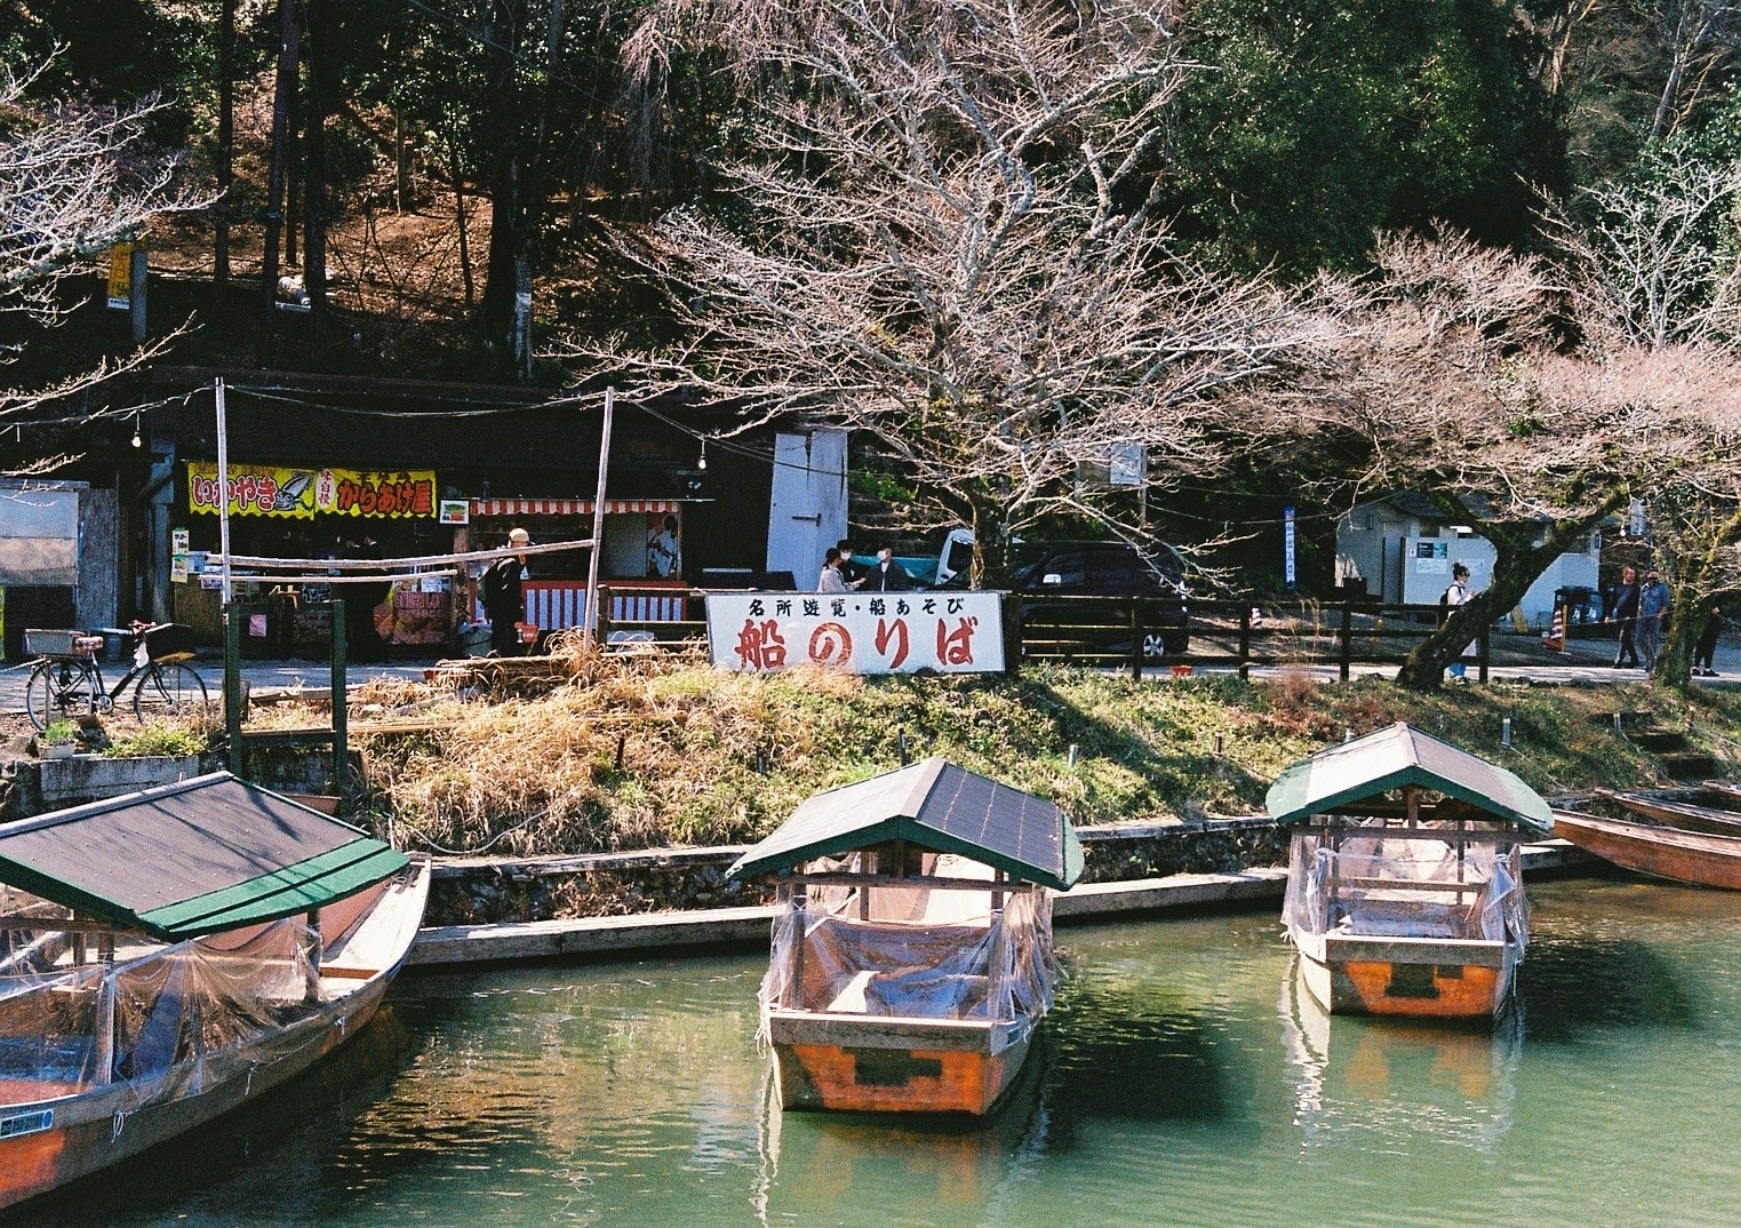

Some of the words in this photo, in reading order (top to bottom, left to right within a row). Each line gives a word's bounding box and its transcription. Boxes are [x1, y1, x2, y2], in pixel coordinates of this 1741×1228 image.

[749, 598, 964, 618] 名所遊覧・船あそび
[734, 616, 978, 670] 船のりば
